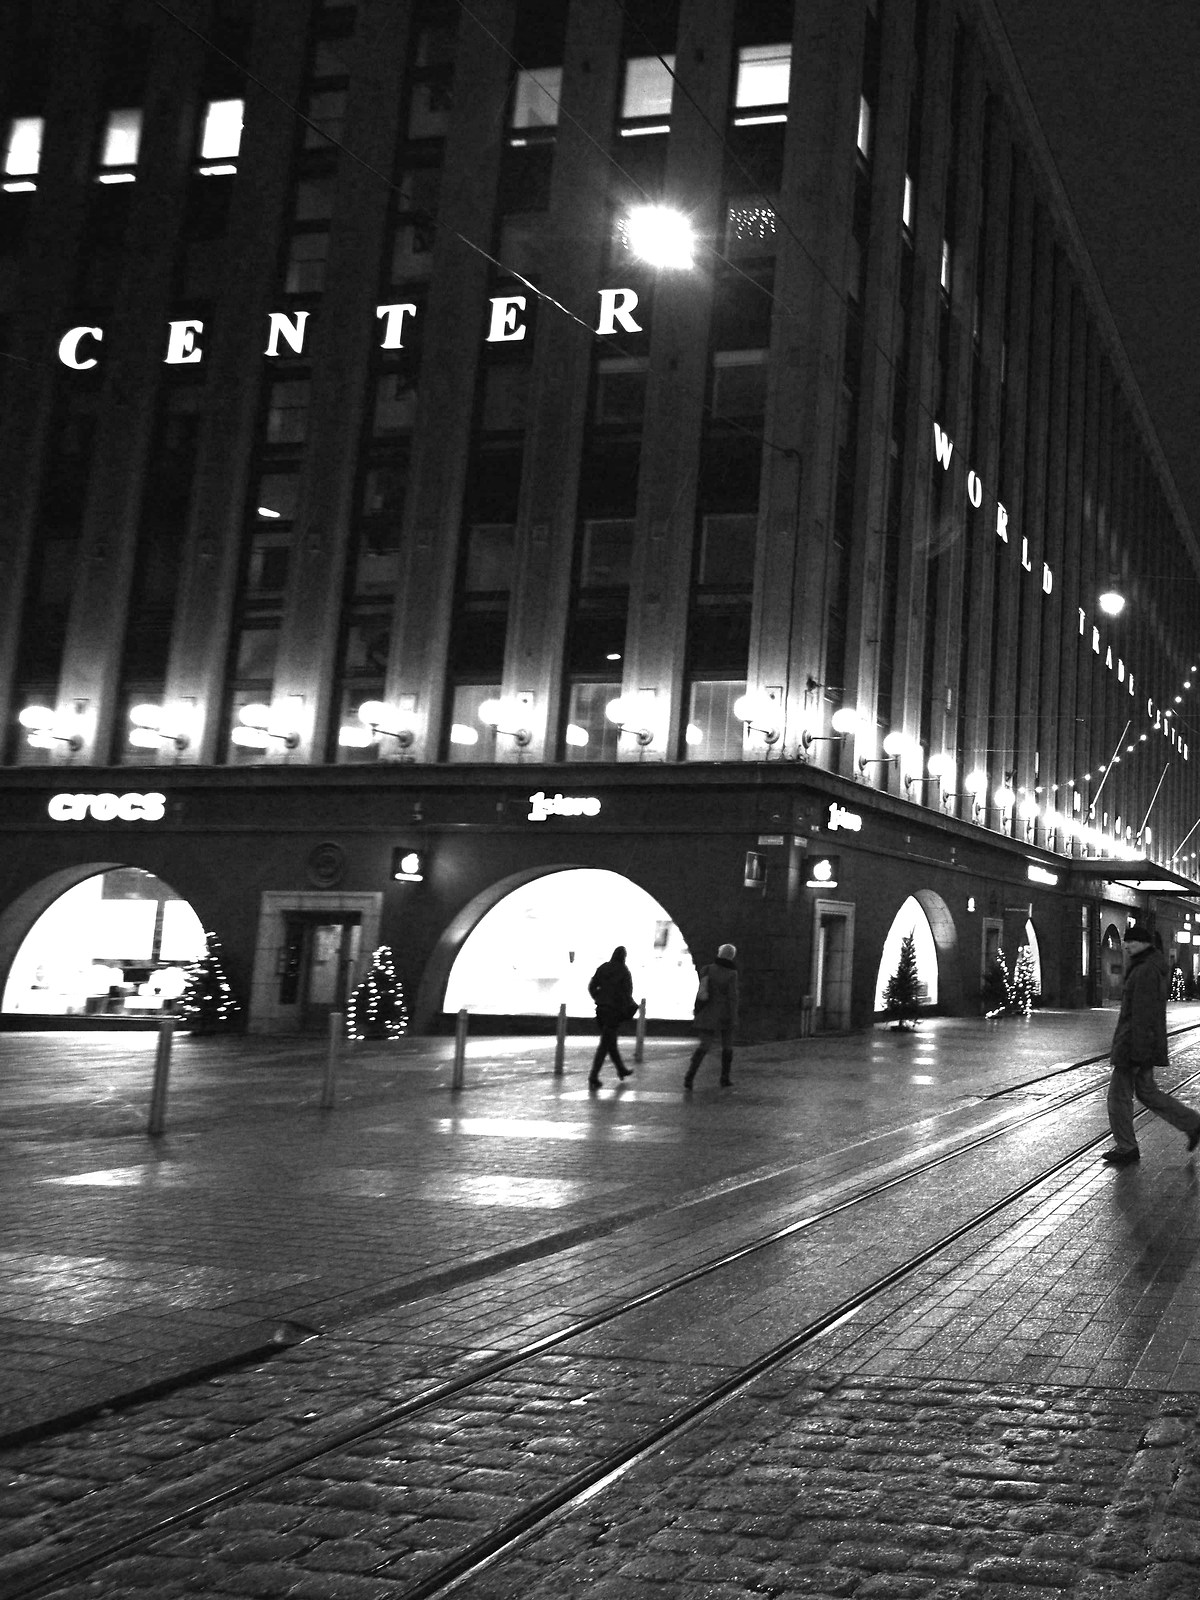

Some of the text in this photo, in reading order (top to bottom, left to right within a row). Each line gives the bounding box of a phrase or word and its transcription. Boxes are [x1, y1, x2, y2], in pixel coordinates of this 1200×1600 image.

[58, 288, 643, 370] CENTER
[933, 422, 1053, 595] WORLD
[1078, 607, 1135, 697] TRADE
[47, 792, 167, 822] crocs
